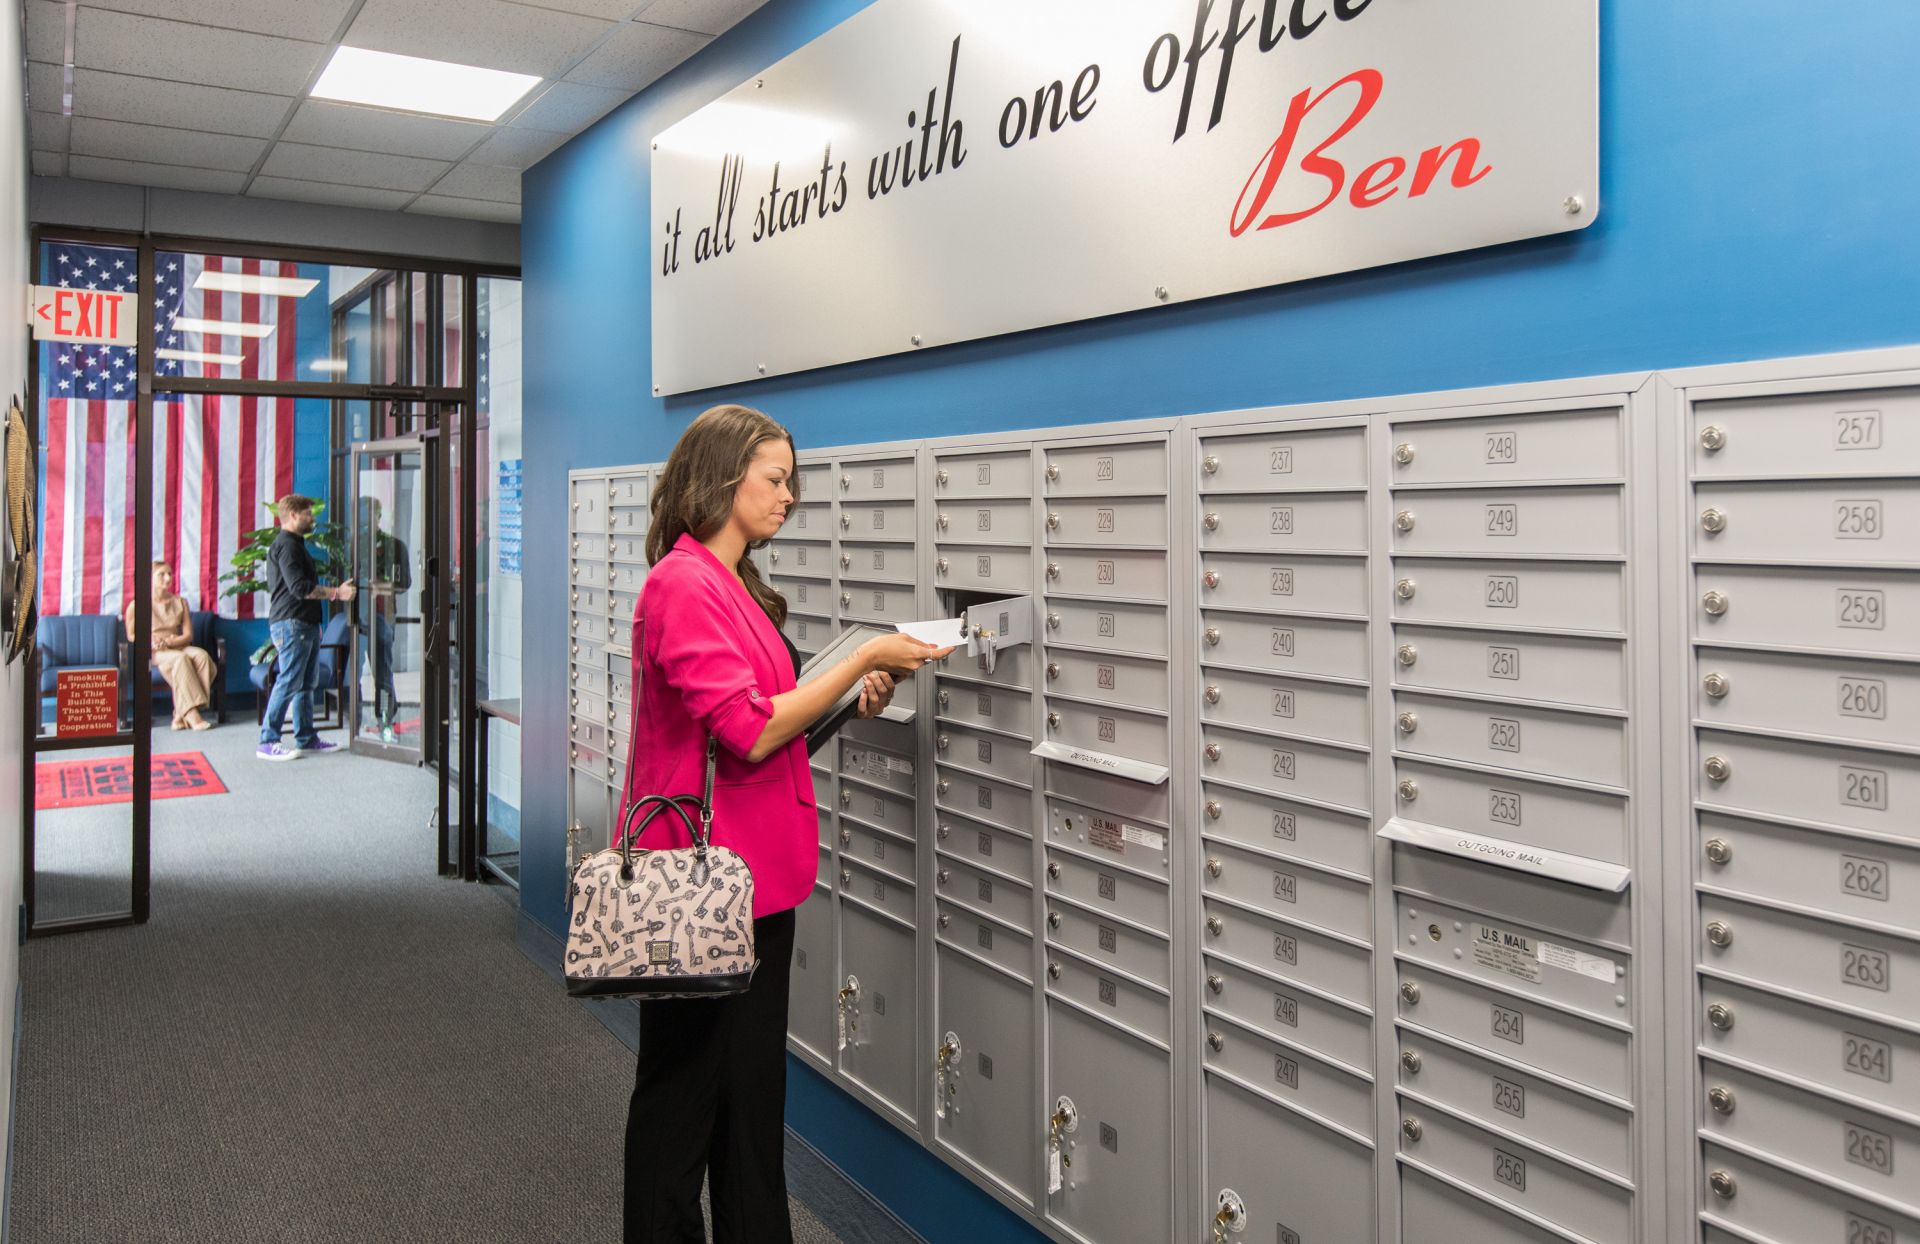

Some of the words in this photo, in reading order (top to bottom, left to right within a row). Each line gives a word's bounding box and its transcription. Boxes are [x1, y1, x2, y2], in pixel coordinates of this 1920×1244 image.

[663, 207, 681, 277] it
[695, 152, 744, 263] all
[753, 138, 848, 243] starts
[867, 33, 967, 200] with
[999, 63, 1101, 149] one
[1229, 68, 1493, 238] Ben
[54, 290, 124, 339] EXIT
[1838, 417, 1876, 445] 257
[1487, 437, 1513, 459] 248
[1097, 460, 1111, 477] 228
[1271, 451, 1290, 470] 237
[1098, 512, 1112, 529] 229
[1272, 511, 1290, 531] 238
[1488, 509, 1513, 532] 249
[1838, 505, 1876, 534] 258
[1098, 564, 1112, 581] 230
[1272, 572, 1291, 592] 239
[1488, 580, 1514, 604] 250
[1840, 595, 1880, 624] 259
[1099, 616, 1112, 633] 231
[1272, 632, 1292, 653] 240
[1492, 651, 1513, 675] 251
[67, 674, 107, 682] Smoking
[70, 681, 116, 689] Prohibited
[1098, 668, 1112, 686] 232
[1275, 693, 1291, 713] 241
[1841, 683, 1881, 713] 260
[62, 707, 91, 715] Thank
[1099, 720, 1113, 739] 233
[1491, 722, 1516, 748] 252
[1273, 754, 1292, 775] 242
[1846, 773, 1879, 802] 261
[1491, 794, 1517, 821] 253
[1274, 815, 1293, 837] 243
[1457, 840, 1515, 859] OUTGOING
[1516, 852, 1543, 865] MAIL
[1274, 876, 1294, 898] 244
[1844, 861, 1882, 894] 262
[1275, 936, 1294, 960] 245
[1481, 927, 1500, 943] U.S.
[1504, 933, 1530, 952] MAIL
[1844, 950, 1885, 985] 263
[1276, 998, 1295, 1022] 246
[1494, 1010, 1519, 1038] 254
[1846, 1039, 1886, 1075] 264
[1276, 1060, 1295, 1083] 247
[1495, 1082, 1521, 1112] 255
[1848, 1129, 1887, 1168] 265
[1496, 1155, 1521, 1185] 256
